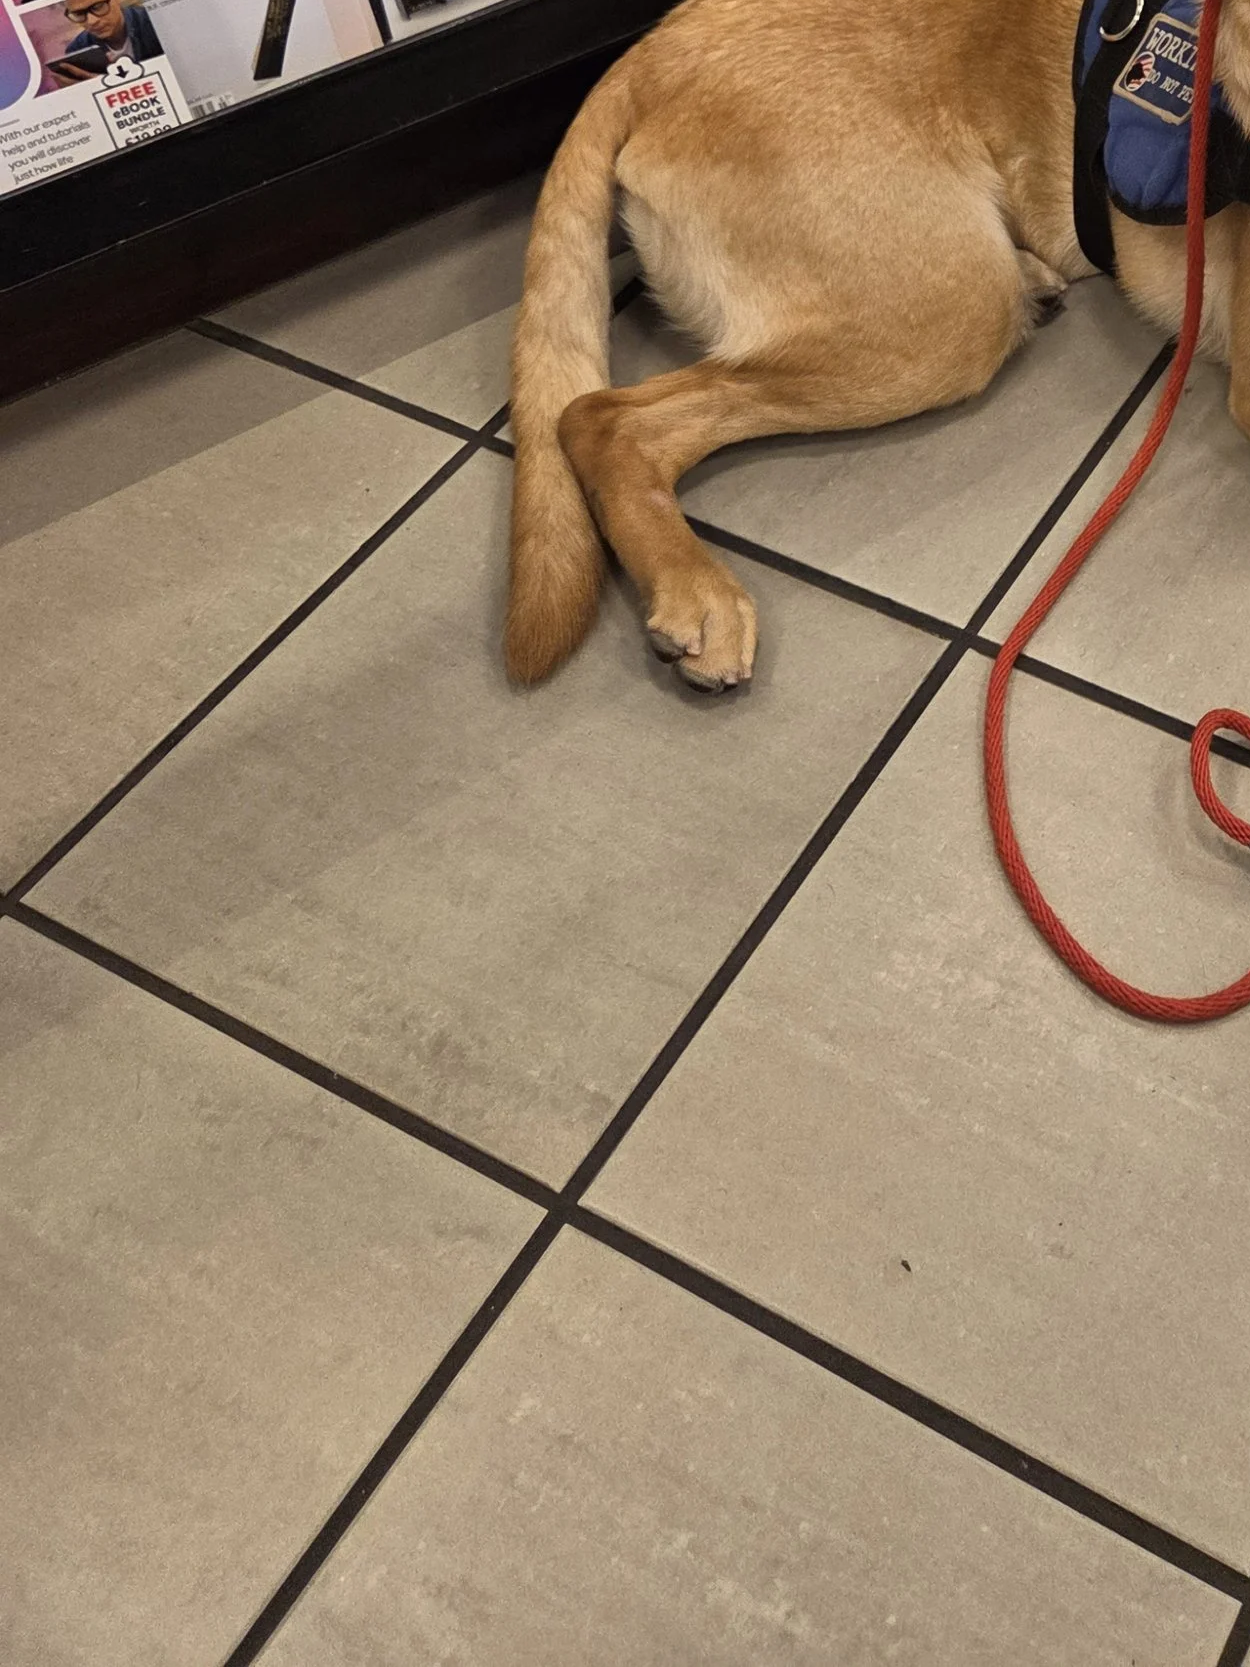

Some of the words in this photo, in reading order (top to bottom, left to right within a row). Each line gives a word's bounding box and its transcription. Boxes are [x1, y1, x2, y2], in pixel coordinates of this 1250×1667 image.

[105, 81, 158, 109] FREE
[112, 95, 161, 120] eBOOK
[24, 123, 42, 137] our
[42, 109, 78, 132] expert
[115, 106, 167, 131] BUNDLE
[128, 120, 161, 135] WORTH
[2, 142, 27, 160] help
[27, 134, 48, 149] and
[48, 119, 93, 140] tutorials
[8, 156, 31, 173] you
[30, 148, 47, 163] will
[46, 134, 93, 157] discover
[13, 167, 36, 186] just
[35, 159, 59, 176] how
[58, 154, 75, 168] life
